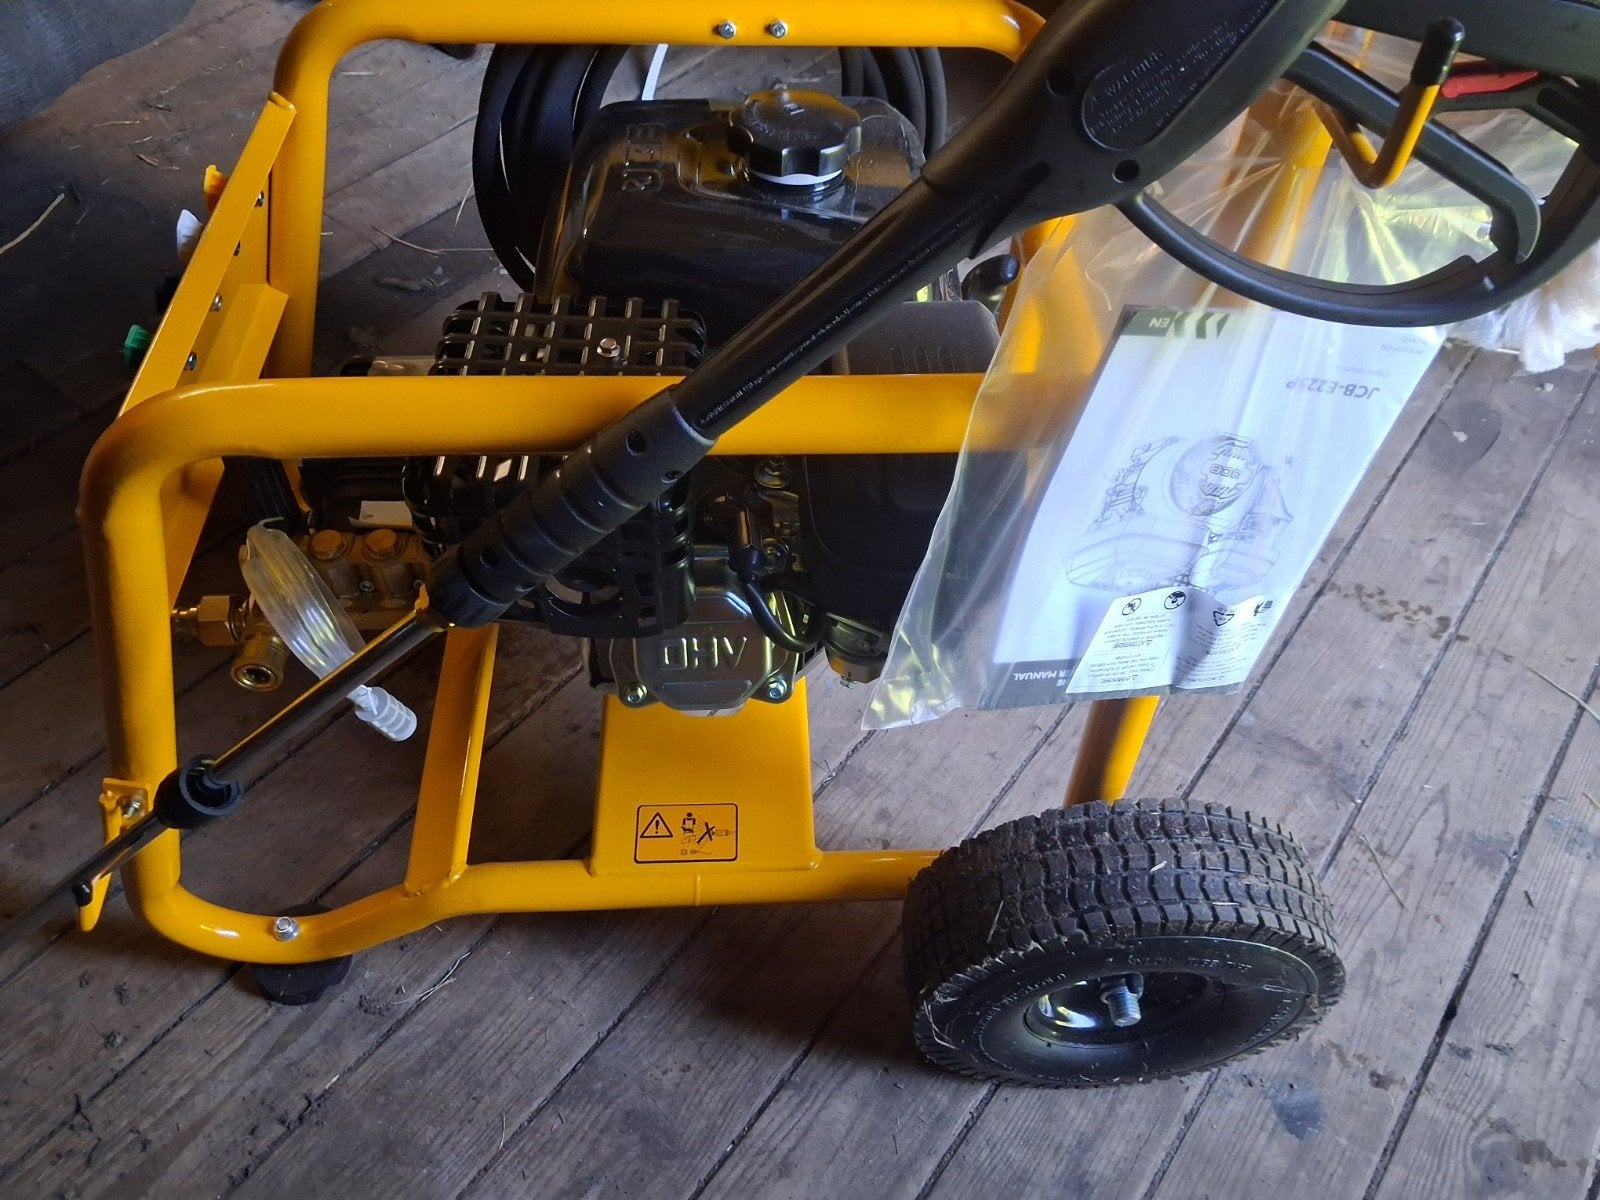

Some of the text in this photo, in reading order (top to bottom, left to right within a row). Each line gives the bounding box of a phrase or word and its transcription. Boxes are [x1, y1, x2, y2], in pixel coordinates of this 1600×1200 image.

[1148, 317, 1171, 328] EN
[1209, 463, 1241, 480] JCB
[657, 636, 748, 670] OHV
[1013, 670, 1057, 681] MANUAL
